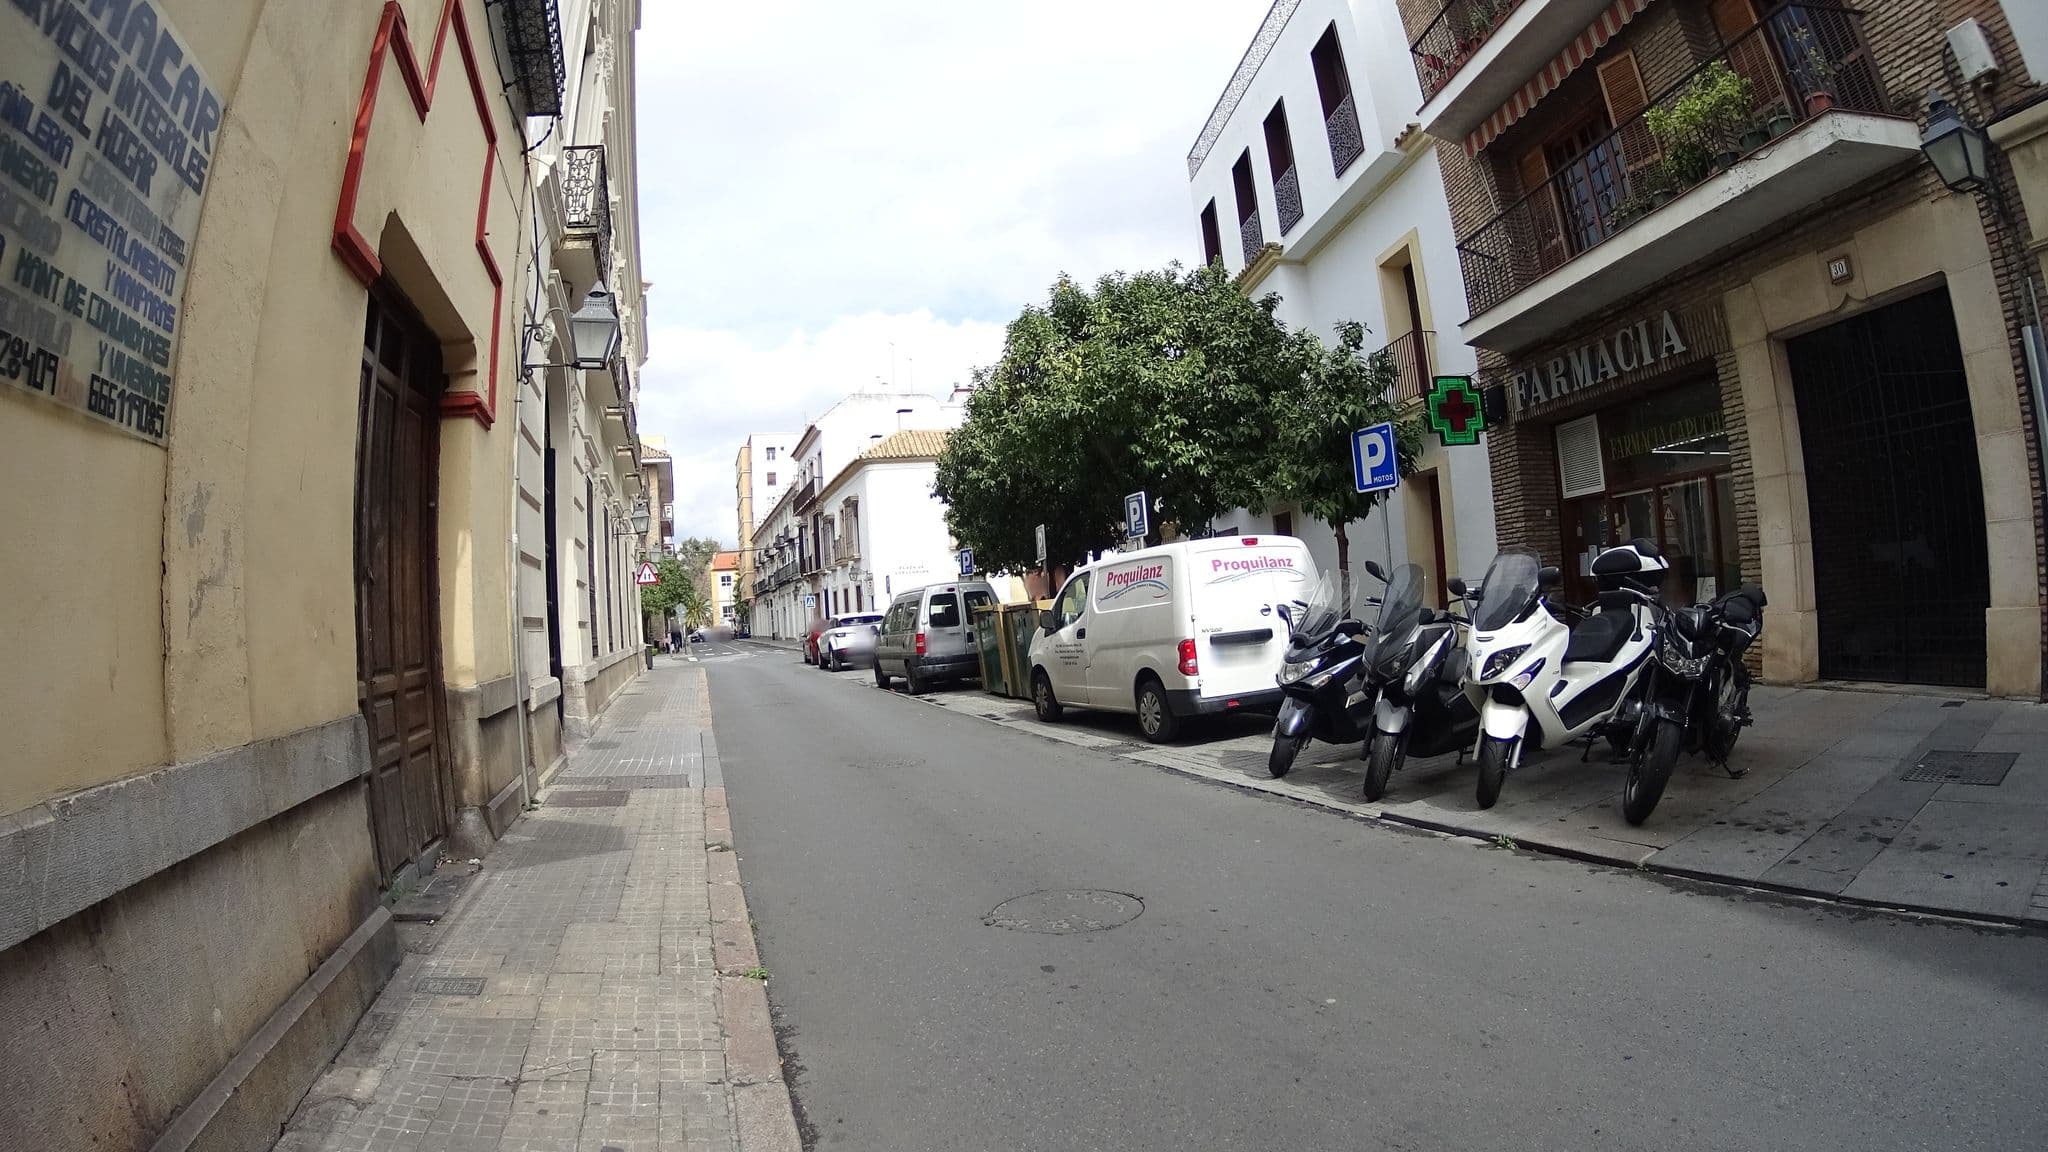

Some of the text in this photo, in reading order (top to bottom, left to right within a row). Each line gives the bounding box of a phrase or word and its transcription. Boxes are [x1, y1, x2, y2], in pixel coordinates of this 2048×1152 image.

[47, 60, 158, 198] DEL HOGAR
[115, 64, 209, 197] INTEGRALES
[14, 247, 64, 307] MANT.
[63, 277, 87, 318] DE
[1832, 262, 1844, 275] 30
[1512, 310, 1686, 412] FARMACIA
[1358, 432, 1386, 486] P
[1609, 426, 1668, 461] FARMACIA
[1373, 474, 1394, 484] MOTOS
[1129, 501, 1140, 531] P
[962, 552, 971, 573] P
[1107, 565, 1163, 587] Proquilanz
[1212, 556, 1294, 573] Proquilanz
